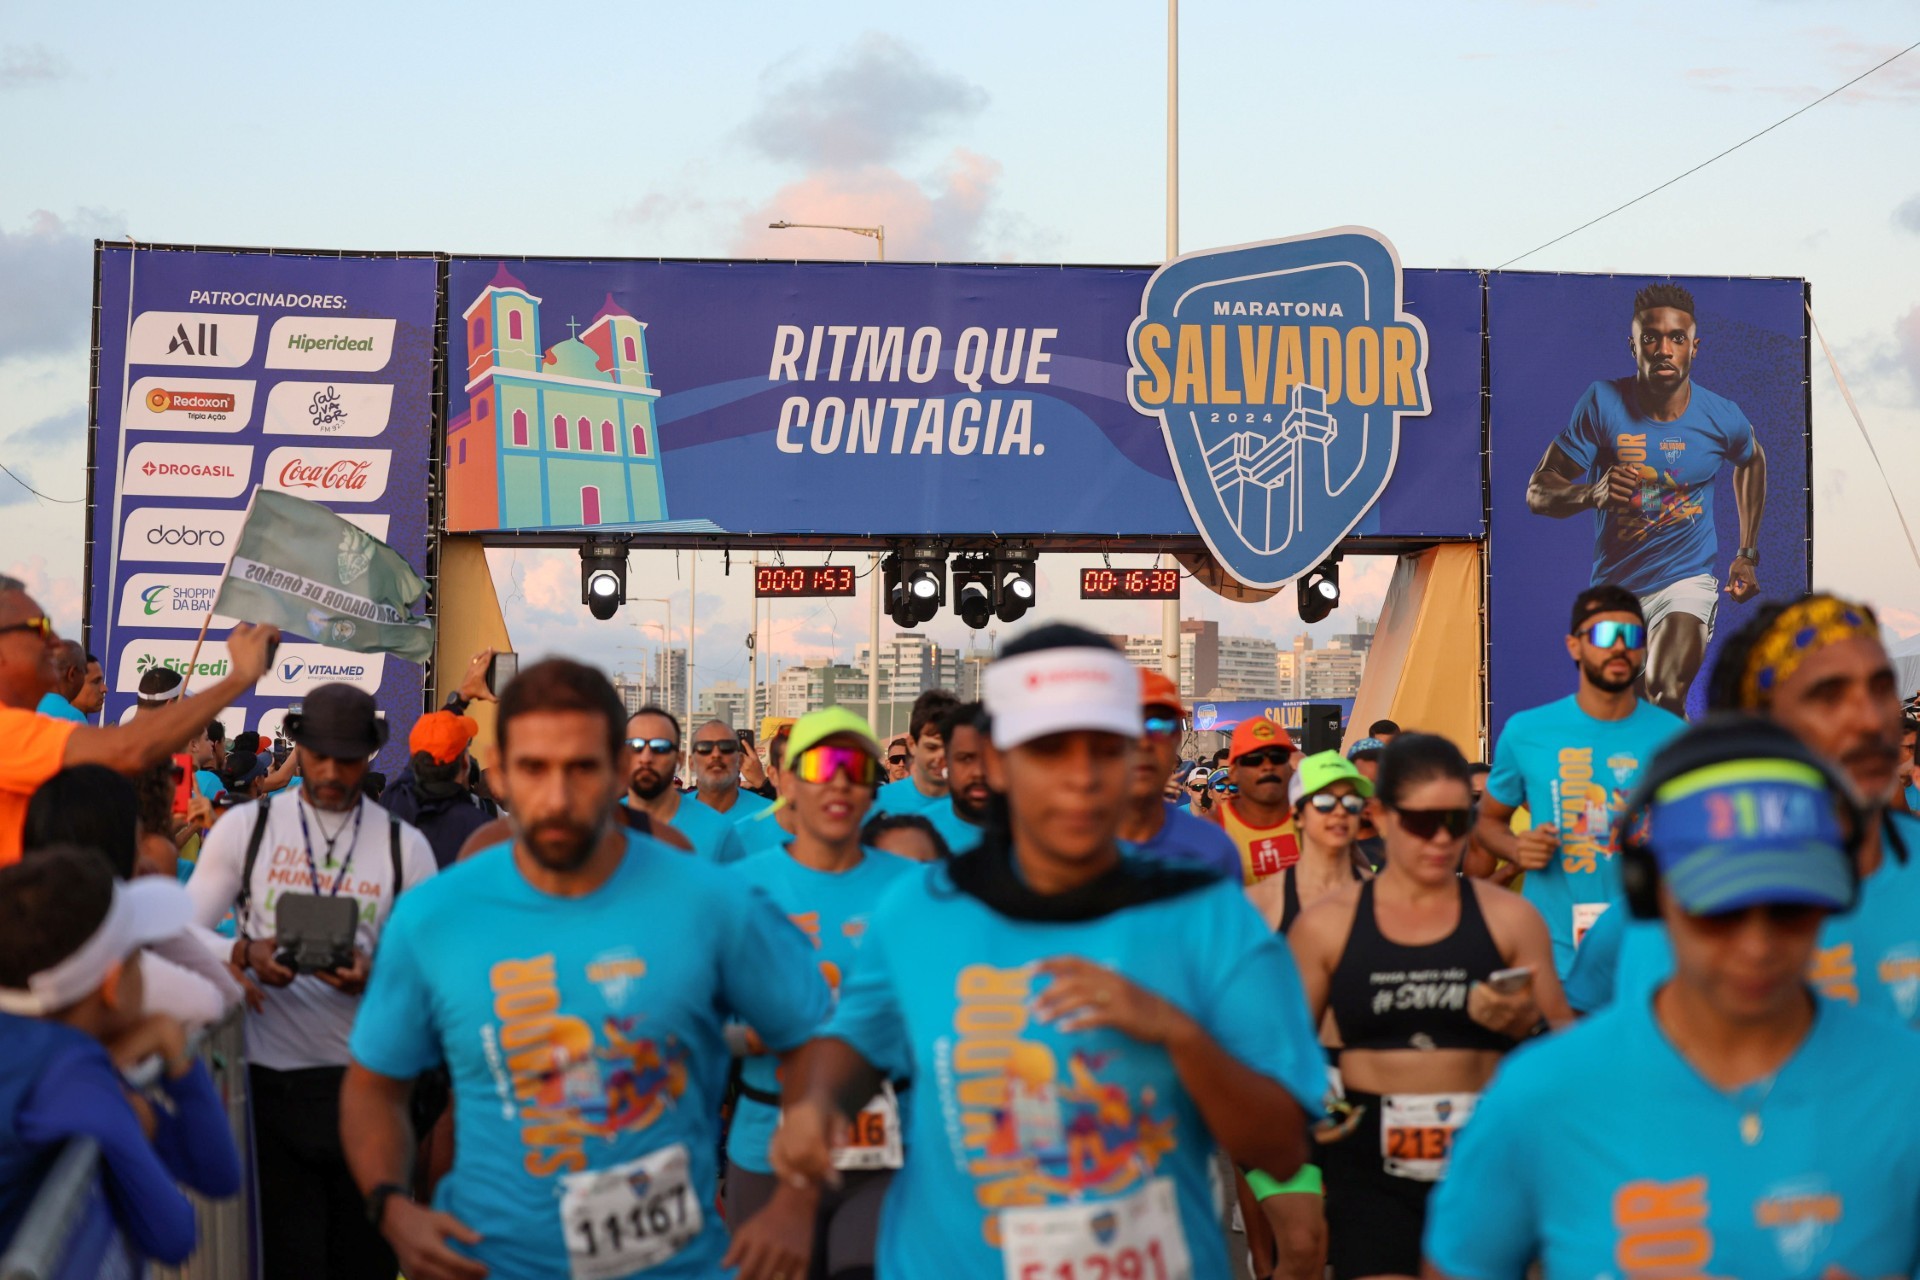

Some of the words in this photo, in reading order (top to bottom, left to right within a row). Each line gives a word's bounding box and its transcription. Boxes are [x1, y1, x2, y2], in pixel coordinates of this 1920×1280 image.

[189, 290, 347, 309] PATROCINADORES:
[1213, 301, 1344, 318] MARATONA
[288, 334, 374, 353] Hiperideal
[768, 325, 941, 384] RITMO
[954, 327, 1058, 393] QUE
[1138, 322, 1418, 407] SALVADOR
[173, 395, 229, 408] Redoxon
[187, 412, 207, 421] Tripla
[207, 412, 227, 421] Ação
[776, 396, 1046, 456] CONTAGIA.
[1210, 411, 1274, 424] 2024
[158, 464, 235, 477] DROGASIL
[279, 458, 373, 490] Coca-Cola
[147, 524, 225, 547] dobro
[758, 569, 851, 591] 00:01:53
[1084, 571, 1177, 592] 00:16:38
[173, 587, 216, 599] SHOPPIN
[172, 598, 190, 611] DA
[163, 657, 228, 676] Sicredi
[308, 664, 365, 676] VITALMED
[1264, 707, 1303, 728] SALVA
[358, 881, 381, 899] DA
[576, 1182, 687, 1257] 11167
